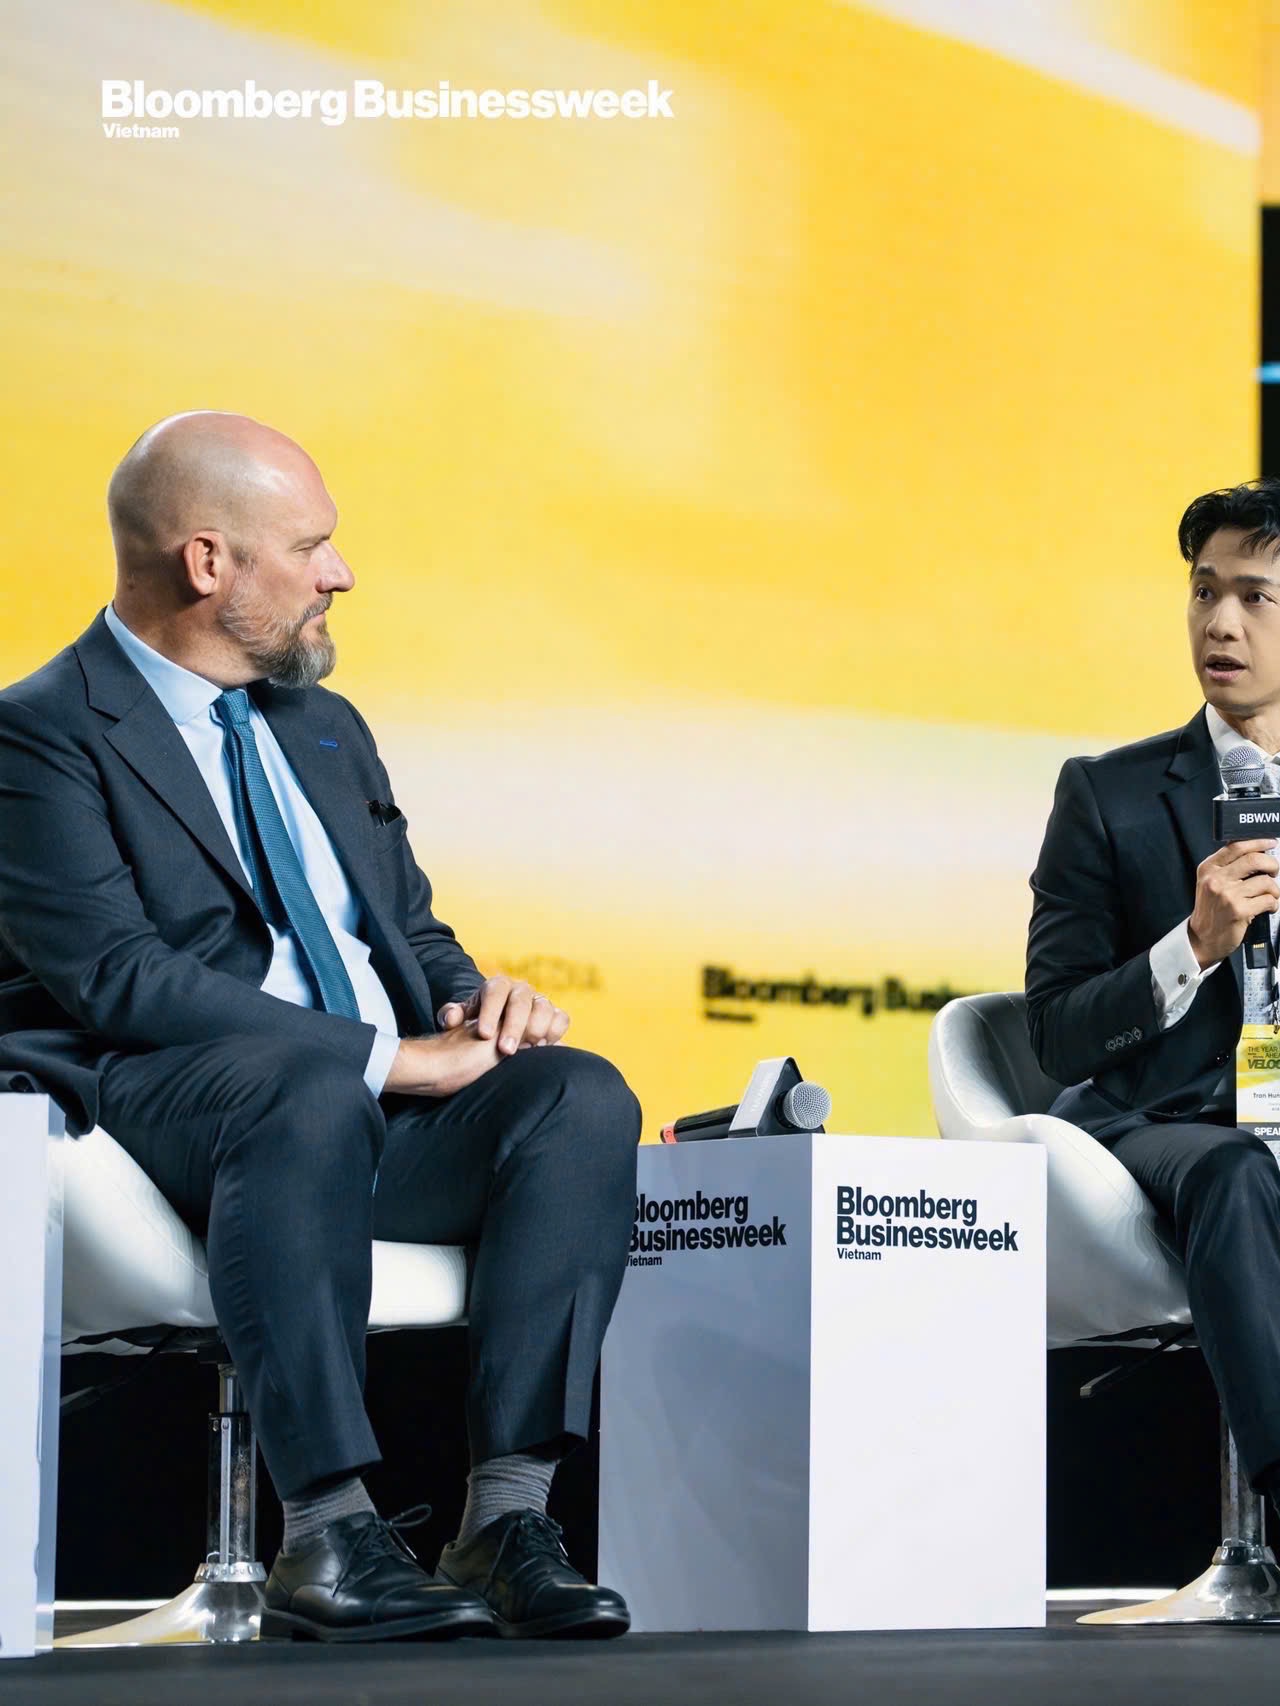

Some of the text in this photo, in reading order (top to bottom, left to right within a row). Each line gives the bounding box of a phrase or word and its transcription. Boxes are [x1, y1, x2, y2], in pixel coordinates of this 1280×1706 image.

[1239, 812, 1280, 824] BBW.VN
[634, 1190, 749, 1225] loomberg
[837, 1186, 978, 1227] Bloomberg
[836, 1216, 1019, 1251] Businessweek
[837, 1247, 882, 1261] Vietnam
